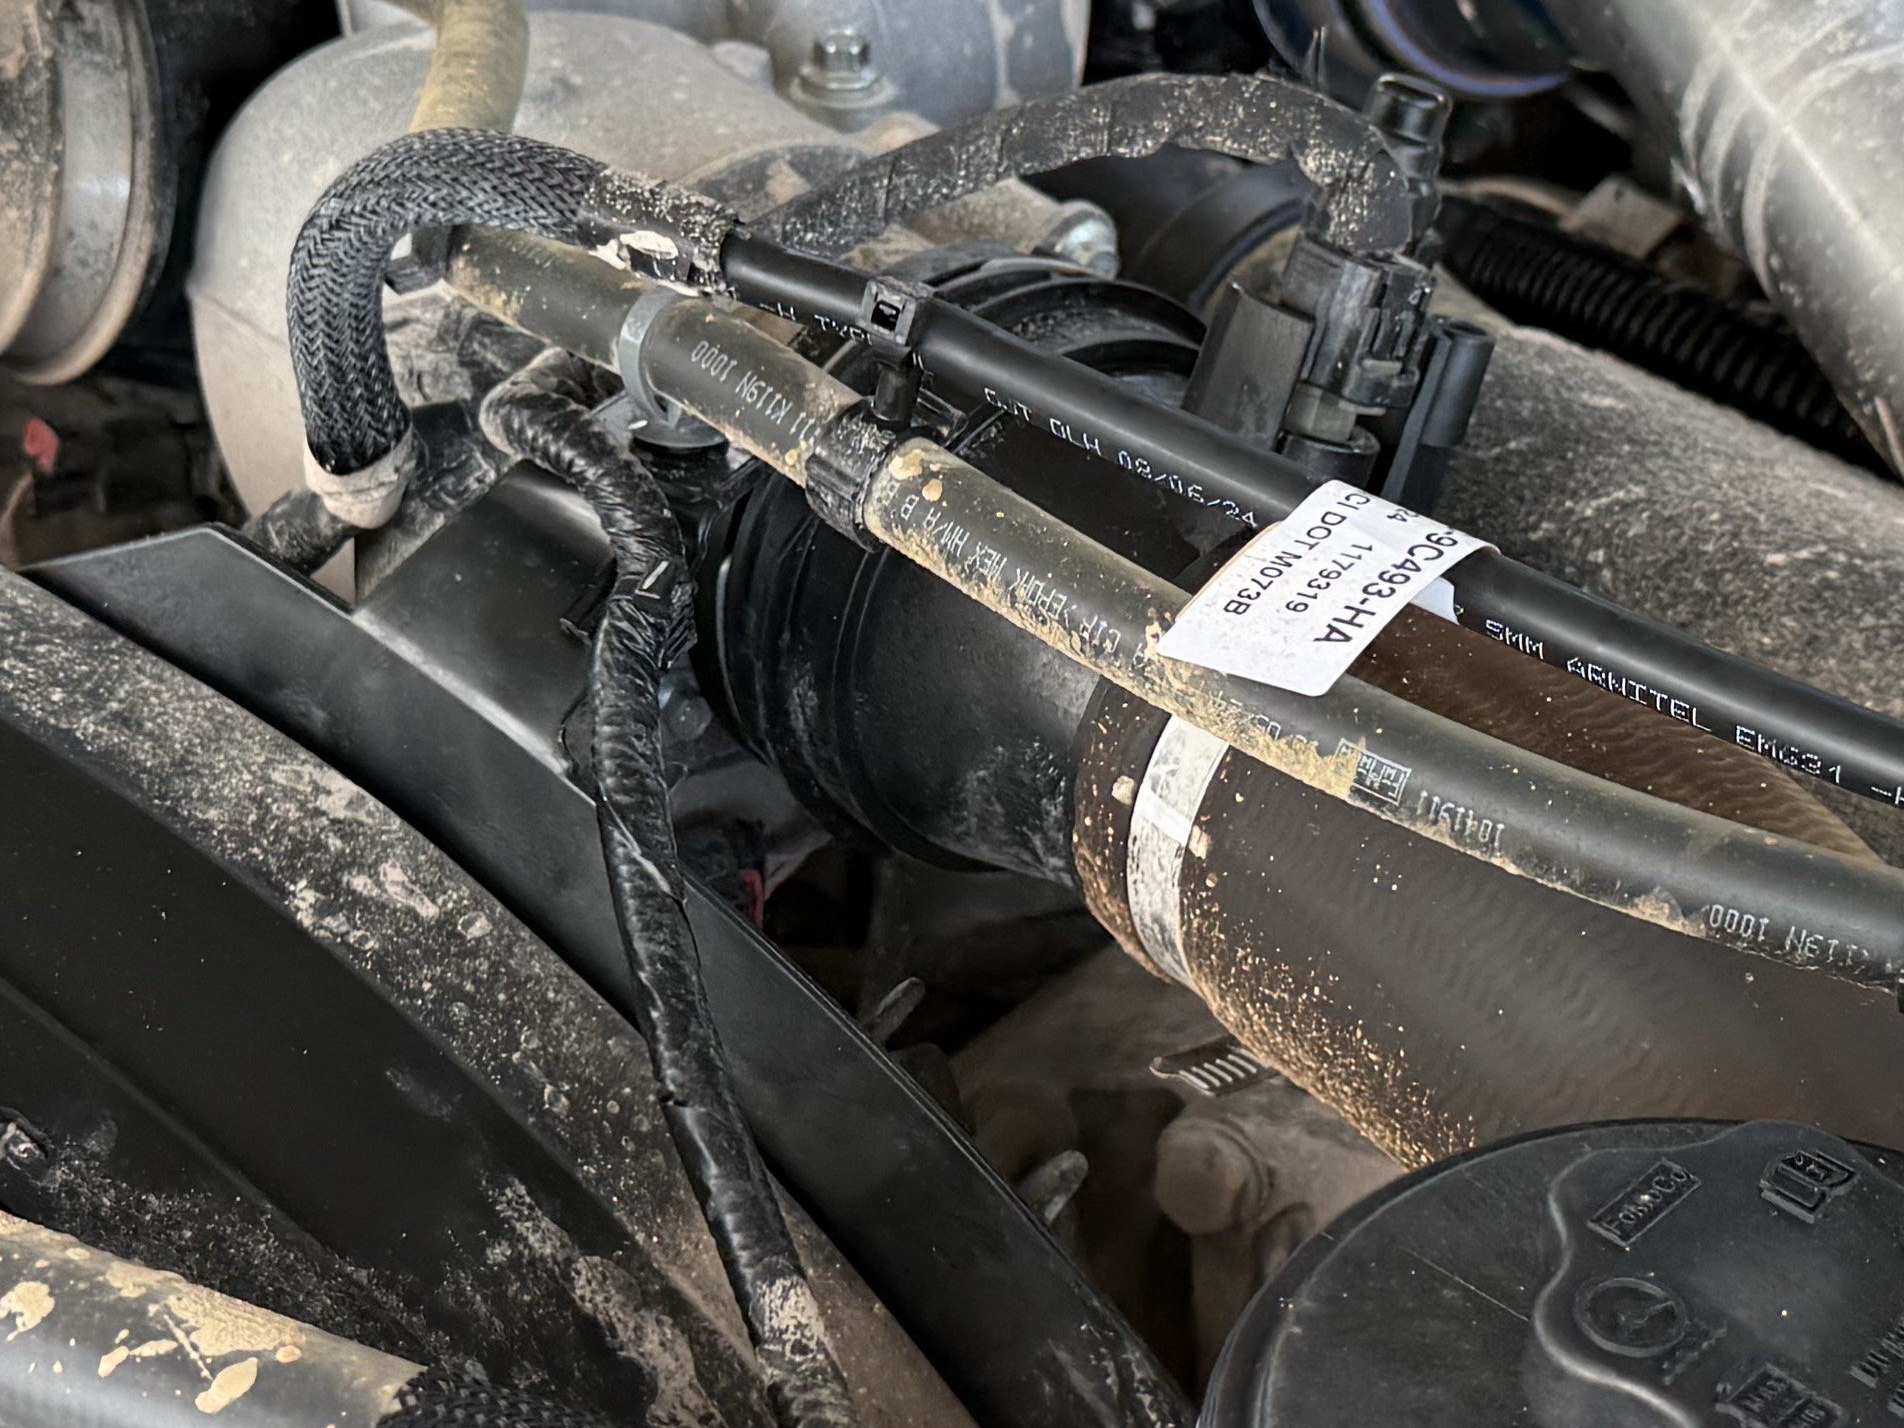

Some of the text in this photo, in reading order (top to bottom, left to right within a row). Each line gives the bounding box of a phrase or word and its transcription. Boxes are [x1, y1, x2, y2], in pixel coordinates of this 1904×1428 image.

[689, 339, 740, 384] 1000
[1293, 510, 1348, 551] DOT
[1223, 549, 1303, 617] M073B
[1285, 542, 1374, 614] 1179319
